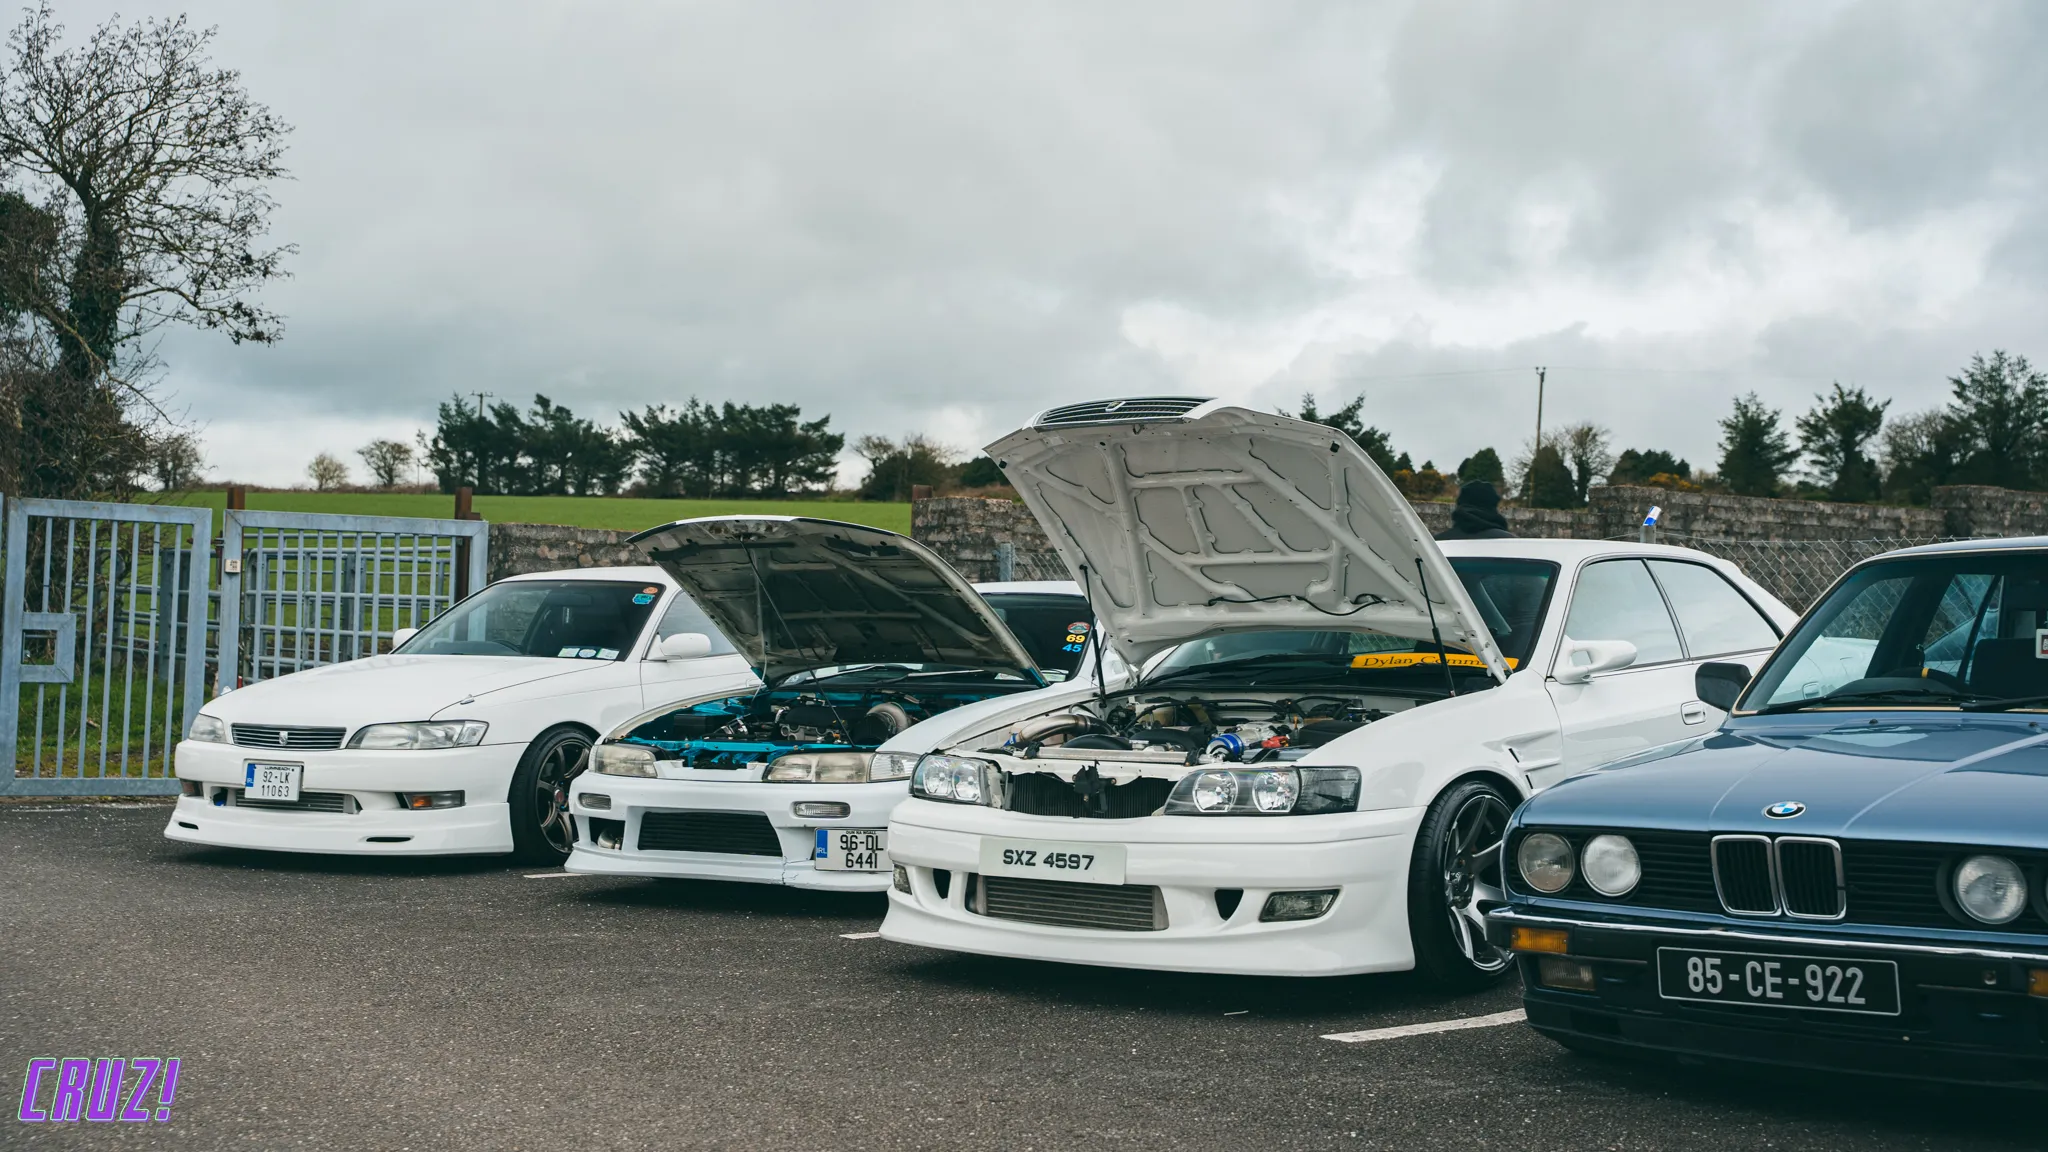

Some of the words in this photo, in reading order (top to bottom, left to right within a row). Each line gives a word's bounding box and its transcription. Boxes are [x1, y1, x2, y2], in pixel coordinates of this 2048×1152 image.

[1066, 634, 1086, 643] 69
[1062, 643, 1082, 652] 45
[1363, 656, 1413, 667] Dylan
[262, 771, 290, 784] 92-LK
[261, 785, 290, 797] 11063
[840, 834, 884, 851] 96-DL
[845, 852, 878, 869] 6441
[1003, 849, 1037, 867] SXZ
[1043, 852, 1095, 870] 4597
[1687, 956, 1866, 1005] 85-CE-922
